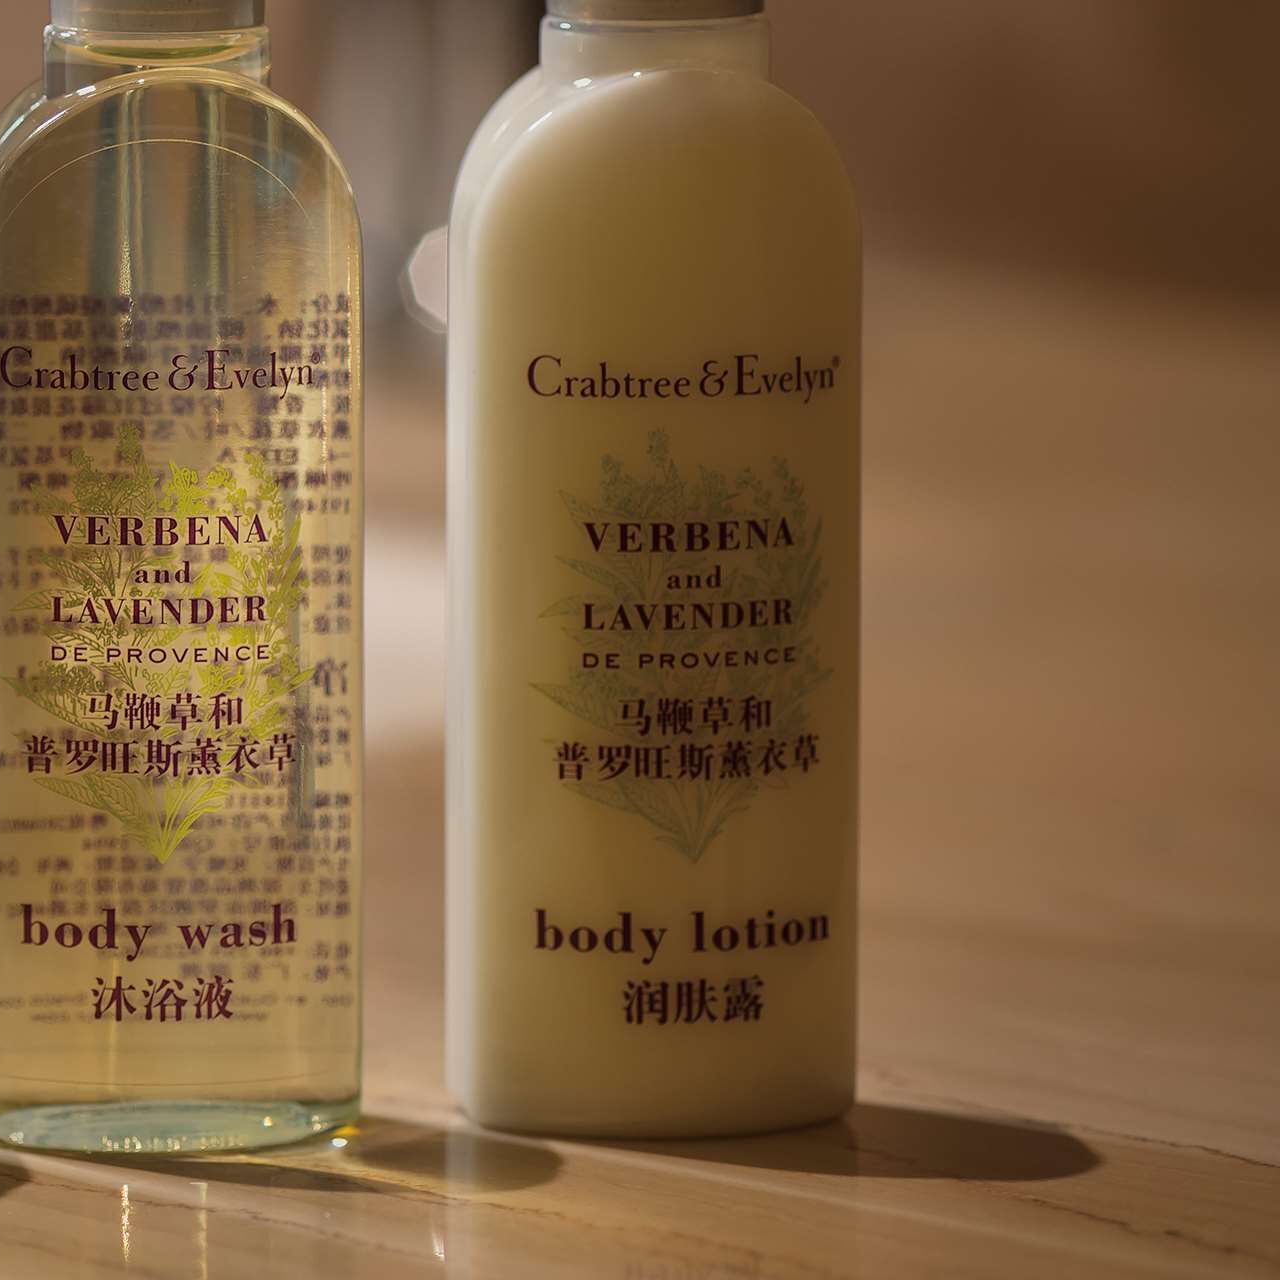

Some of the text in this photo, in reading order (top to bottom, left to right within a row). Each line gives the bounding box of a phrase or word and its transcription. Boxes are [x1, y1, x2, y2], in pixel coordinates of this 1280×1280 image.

[0, 345, 159, 392] Crabtree
[167, 353, 200, 391] &
[527, 354, 690, 399] Crabtree
[699, 360, 729, 397] &
[51, 513, 269, 547] VERBENA
[583, 517, 796, 554] VERBENA
[134, 560, 190, 584] and
[666, 565, 722, 590] and
[51, 595, 267, 626] LAVENDER
[582, 598, 794, 632] LAVENDER
[51, 644, 271, 663] DE PROVENCE
[582, 646, 798, 669] DE PROVENCE
[81, 692, 244, 732] 马鞭草和
[616, 695, 774, 737] 马鞭草和
[20, 733, 297, 779] 普罗旺斯薰衣草
[552, 733, 821, 782] 普罗旺斯薰衣草
[20, 903, 152, 962] body
[177, 903, 299, 948] wash
[534, 908, 831, 965] body lotion
[90, 975, 235, 1023] 沐浴液
[621, 974, 767, 1026] 润肤露
